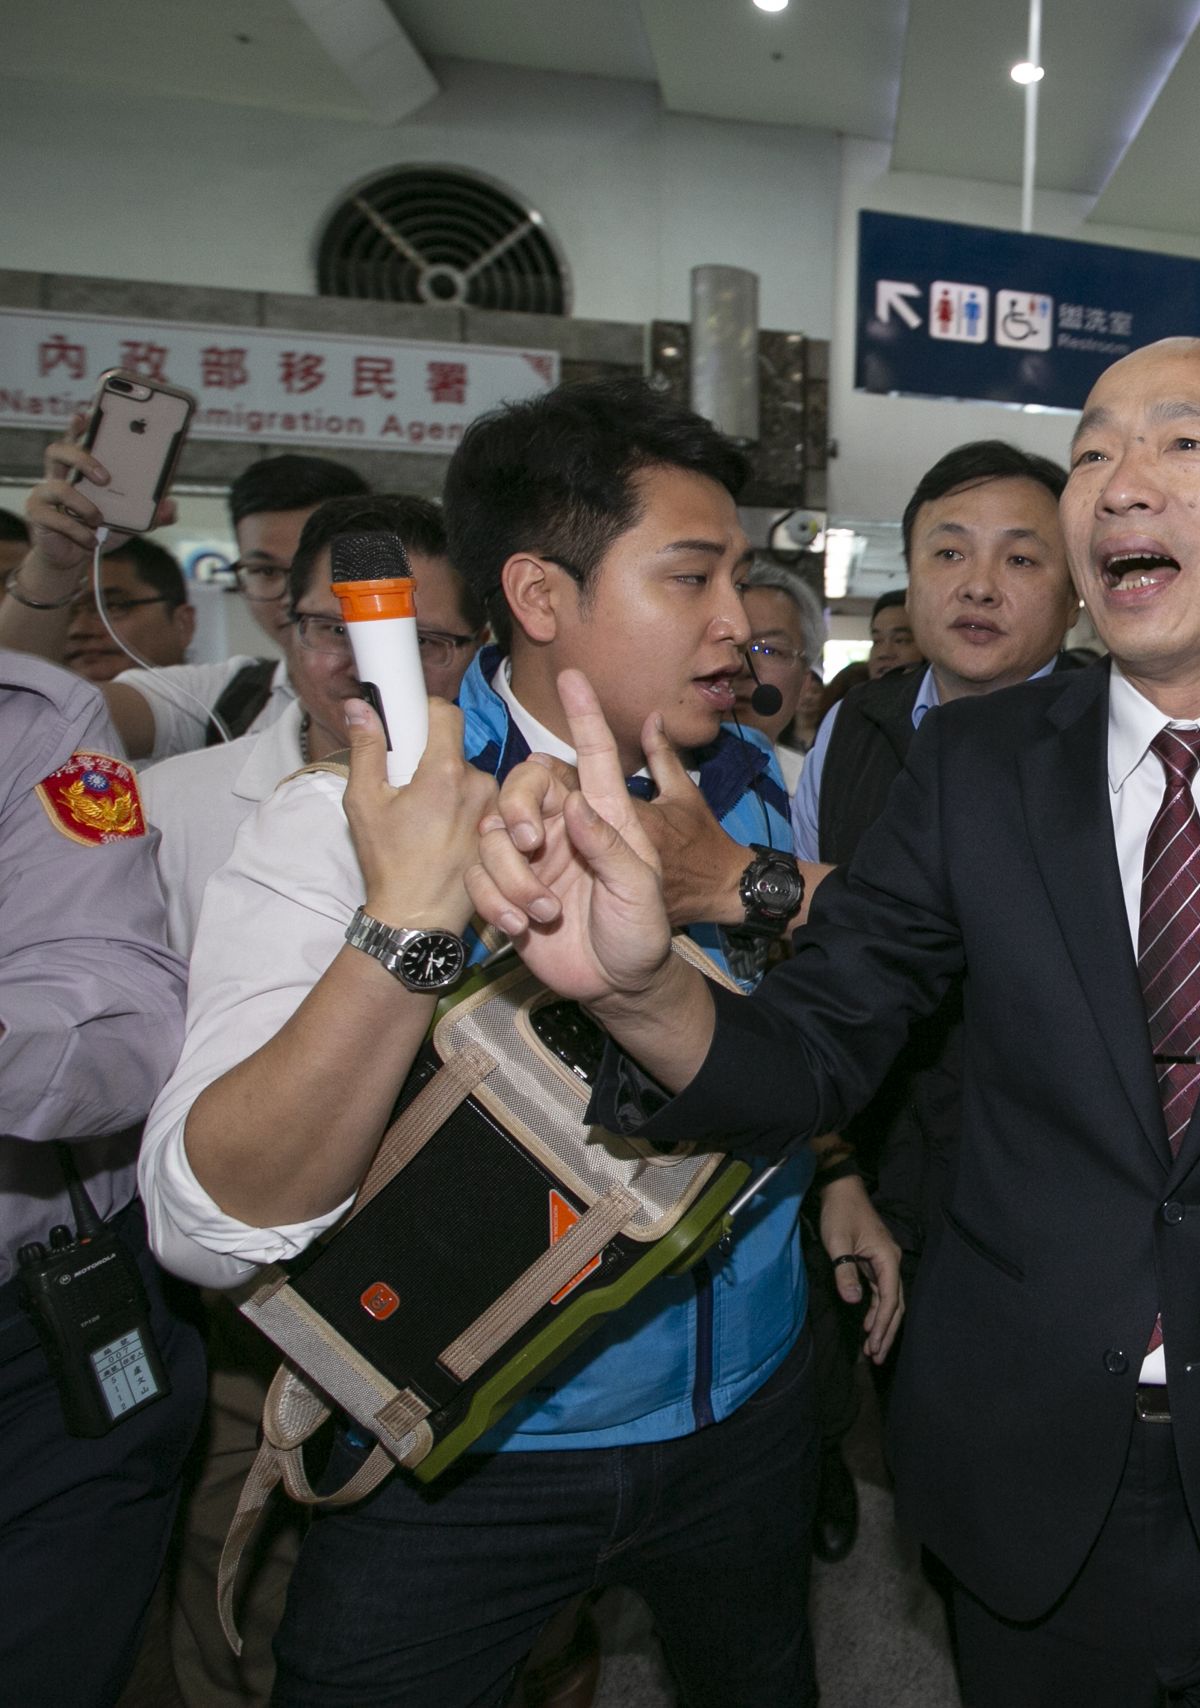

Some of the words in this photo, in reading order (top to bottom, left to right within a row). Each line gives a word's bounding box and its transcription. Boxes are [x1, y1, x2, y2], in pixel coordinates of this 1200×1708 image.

[1058, 302, 1133, 336] 盥洗室
[381, 414, 465, 443] Agen
[74, 1252, 117, 1279] MOTOROLA
